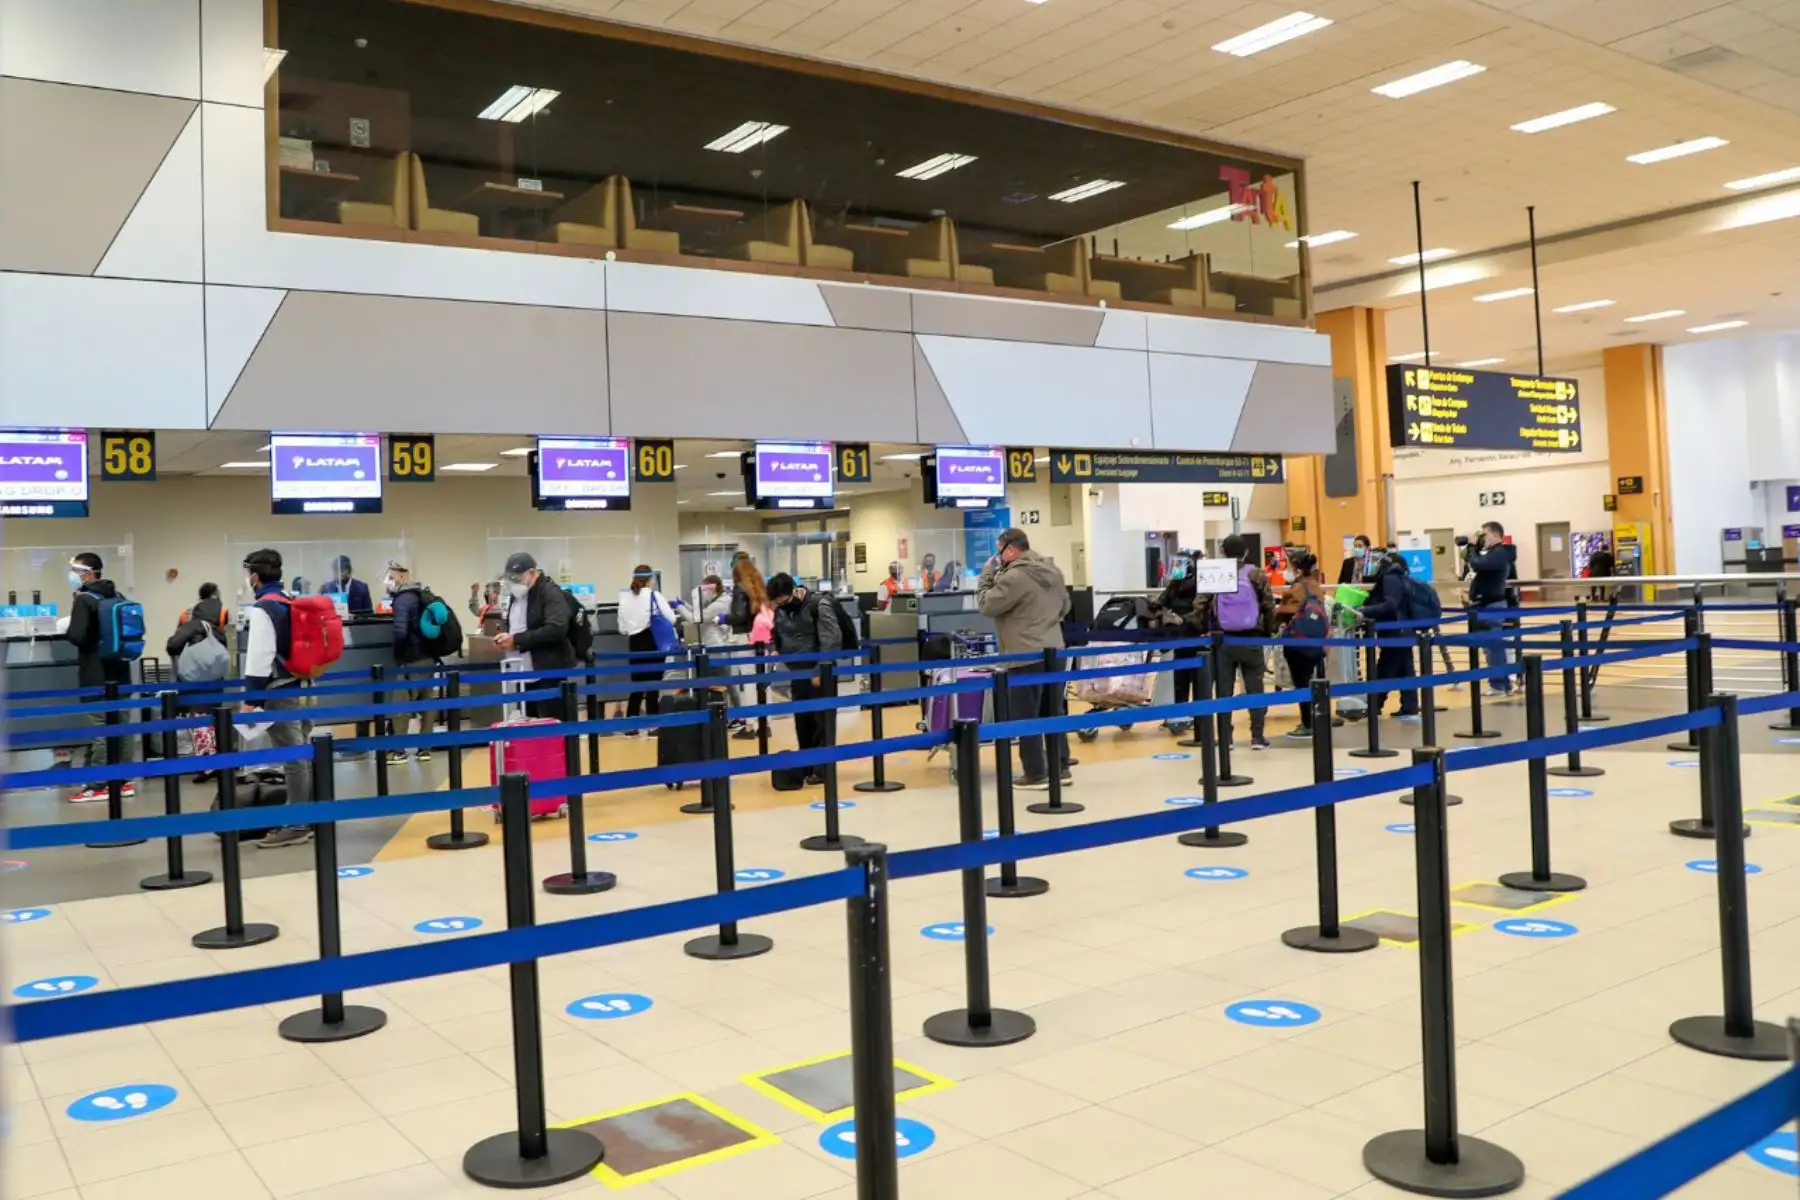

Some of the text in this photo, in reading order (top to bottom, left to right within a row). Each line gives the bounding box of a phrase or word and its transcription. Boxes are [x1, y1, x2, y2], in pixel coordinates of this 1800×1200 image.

[105, 437, 152, 475] 58
[393, 442, 432, 476] 59
[639, 445, 672, 477] 60
[842, 447, 868, 478] 61
[1010, 451, 1034, 478] 62
[1759, 550, 1767, 562] 1
